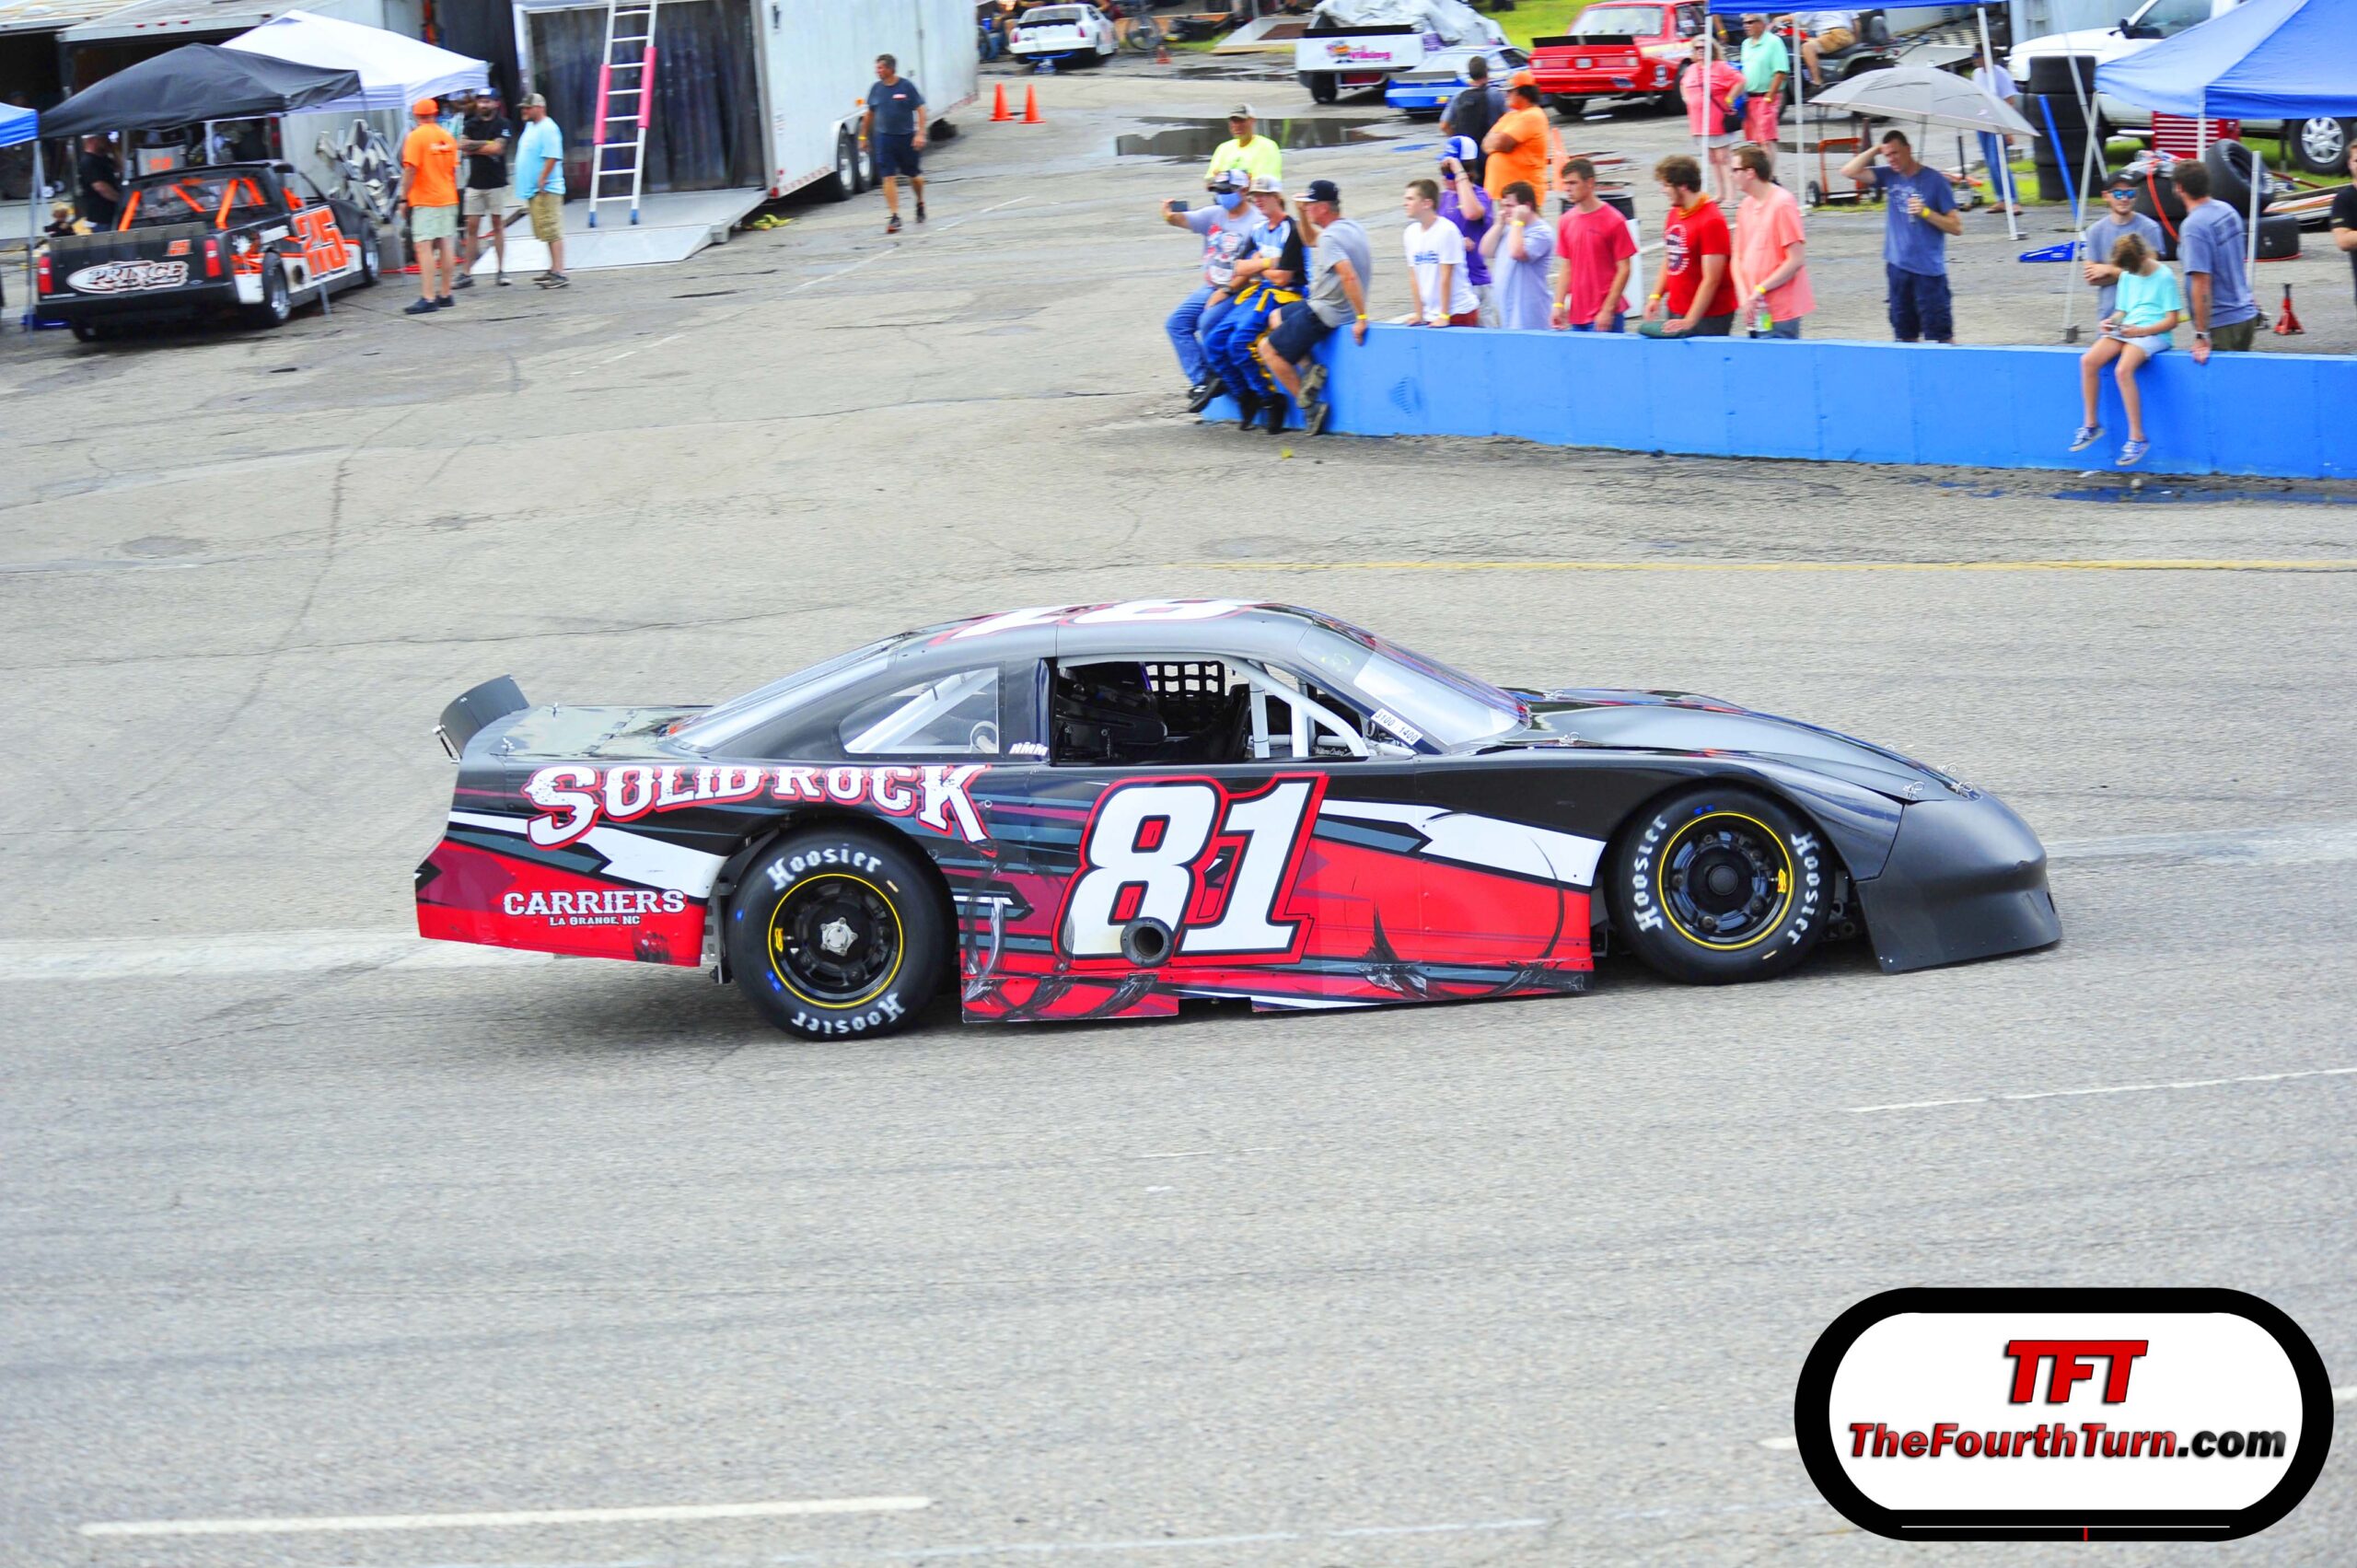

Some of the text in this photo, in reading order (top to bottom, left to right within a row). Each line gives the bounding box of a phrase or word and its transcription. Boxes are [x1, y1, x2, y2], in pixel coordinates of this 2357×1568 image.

[523, 763, 997, 855] SOLID ROCK
[502, 889, 687, 916] CARRIERS
[766, 842, 883, 893] Hoosier
[1057, 775, 1320, 959] 81
[1632, 814, 1668, 934] Hoosier
[1787, 830, 1821, 946] Hoosier
[621, 914, 641, 924] NC
[790, 992, 907, 1035] Hoosier
